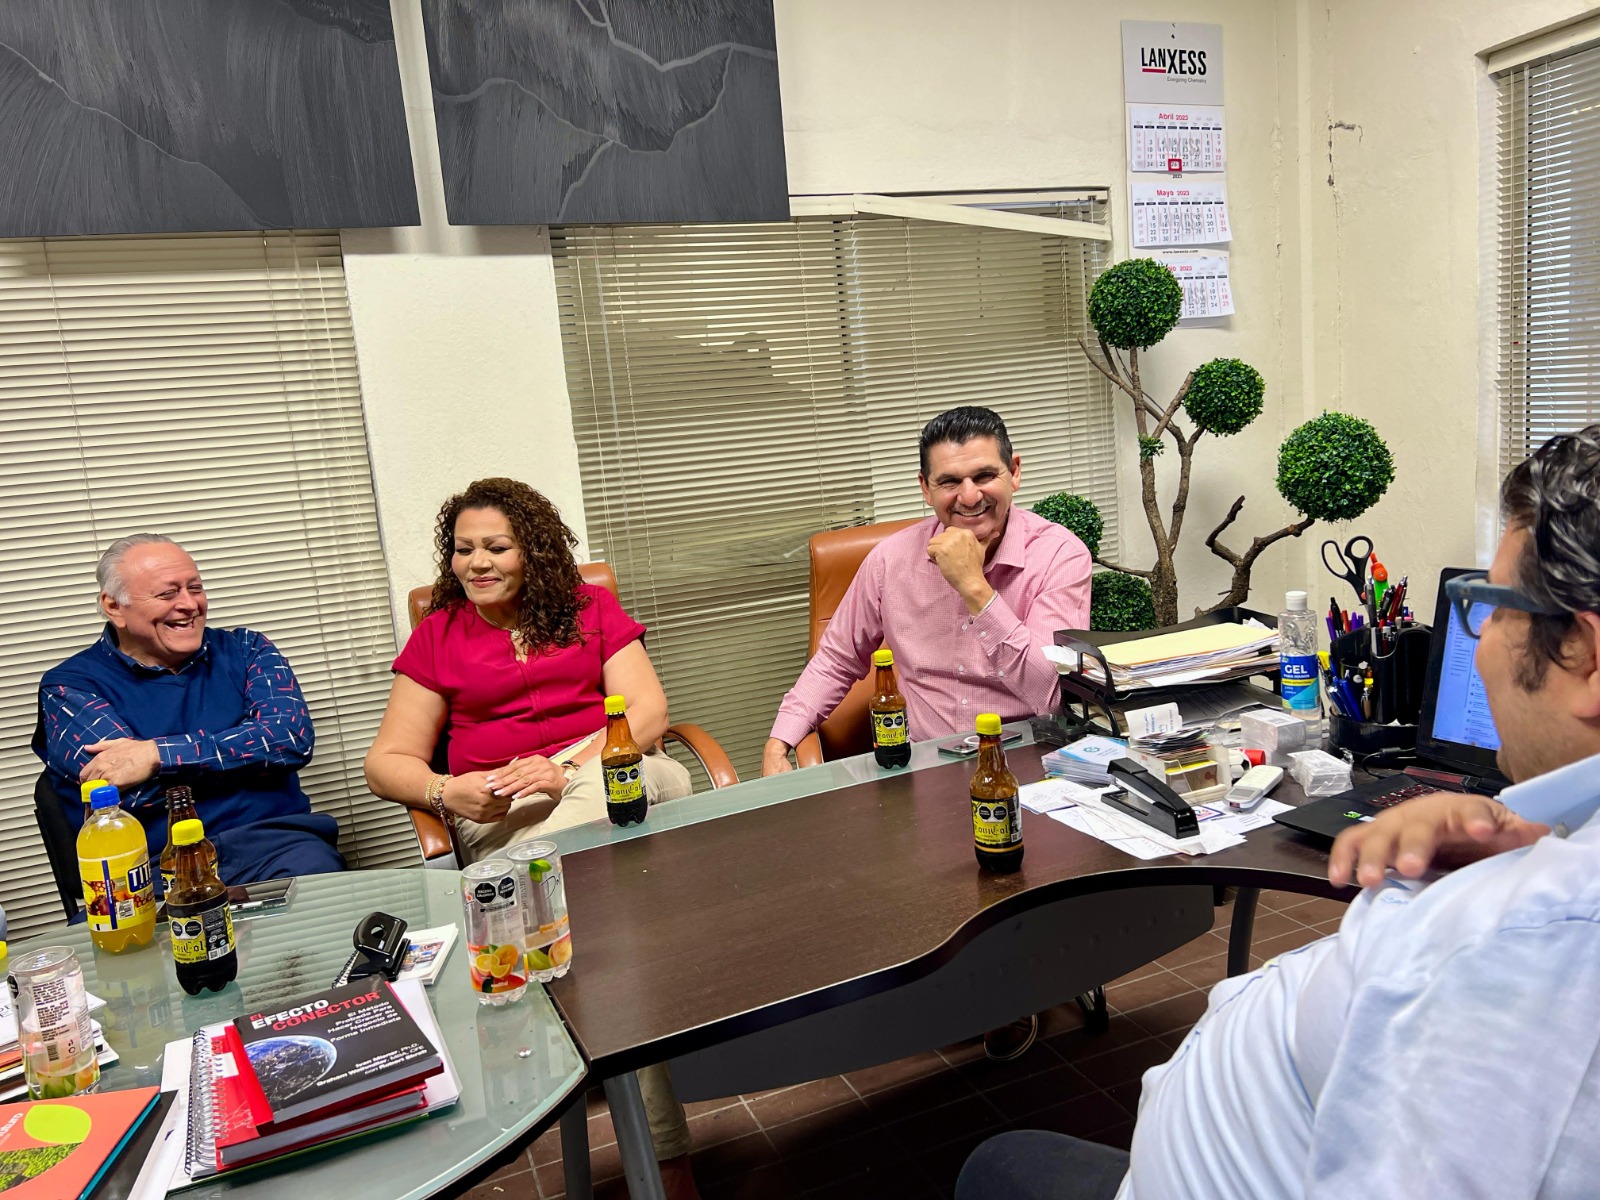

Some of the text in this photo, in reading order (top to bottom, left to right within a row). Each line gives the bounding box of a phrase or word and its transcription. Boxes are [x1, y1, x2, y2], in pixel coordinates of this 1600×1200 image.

[1141, 47, 1206, 76] LANXESS
[1285, 665, 1307, 674] GEL
[129, 862, 152, 887] TIT
[251, 1000, 329, 1030] EFECTO
[272, 991, 380, 1031] CONECTOR
[327, 1022, 353, 1033] Hacer
[354, 1013, 382, 1024] Crecer
[335, 1005, 392, 1026] Probado Para
[350, 1016, 385, 1031] Negocio
[330, 1016, 401, 1042] Forma Inmediata
